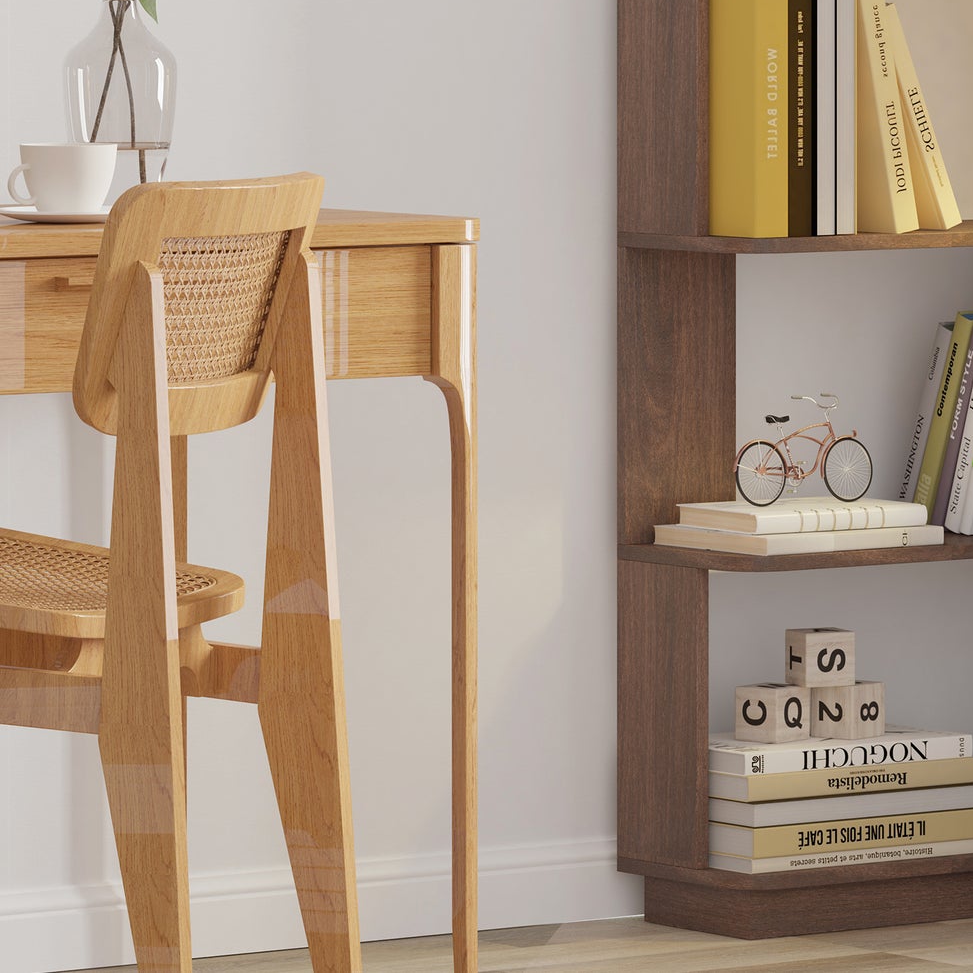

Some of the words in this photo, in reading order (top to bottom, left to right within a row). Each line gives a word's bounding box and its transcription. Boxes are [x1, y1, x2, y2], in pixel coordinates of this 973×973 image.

[928, 346, 940, 381] Columbia
[950, 396, 964, 440] FORM
[960, 349, 973, 395] STYLE
[900, 415, 926, 500] WASHINGTON
[950, 483, 962, 514] State
[957, 436, 972, 480] Capital
[817, 648, 846, 672] S
[742, 699, 767, 726] C
[784, 696, 802, 729] Q
[818, 700, 843, 722] 2
[860, 701, 879, 722] 8
[802, 740, 928, 770] NOGUCHI
[828, 772, 907, 790] Remodelista
[826, 828, 838, 844] LE
[841, 826, 862, 843] FOIS
[865, 824, 884, 841] UNE
[887, 822, 914, 840] ÉTAIT
[917, 820, 926, 836] IL
[798, 830, 823, 850] CAFÉ
[790, 858, 815, 866] secrets
[818, 855, 838, 864] petits
[865, 850, 901, 859] botanique,
